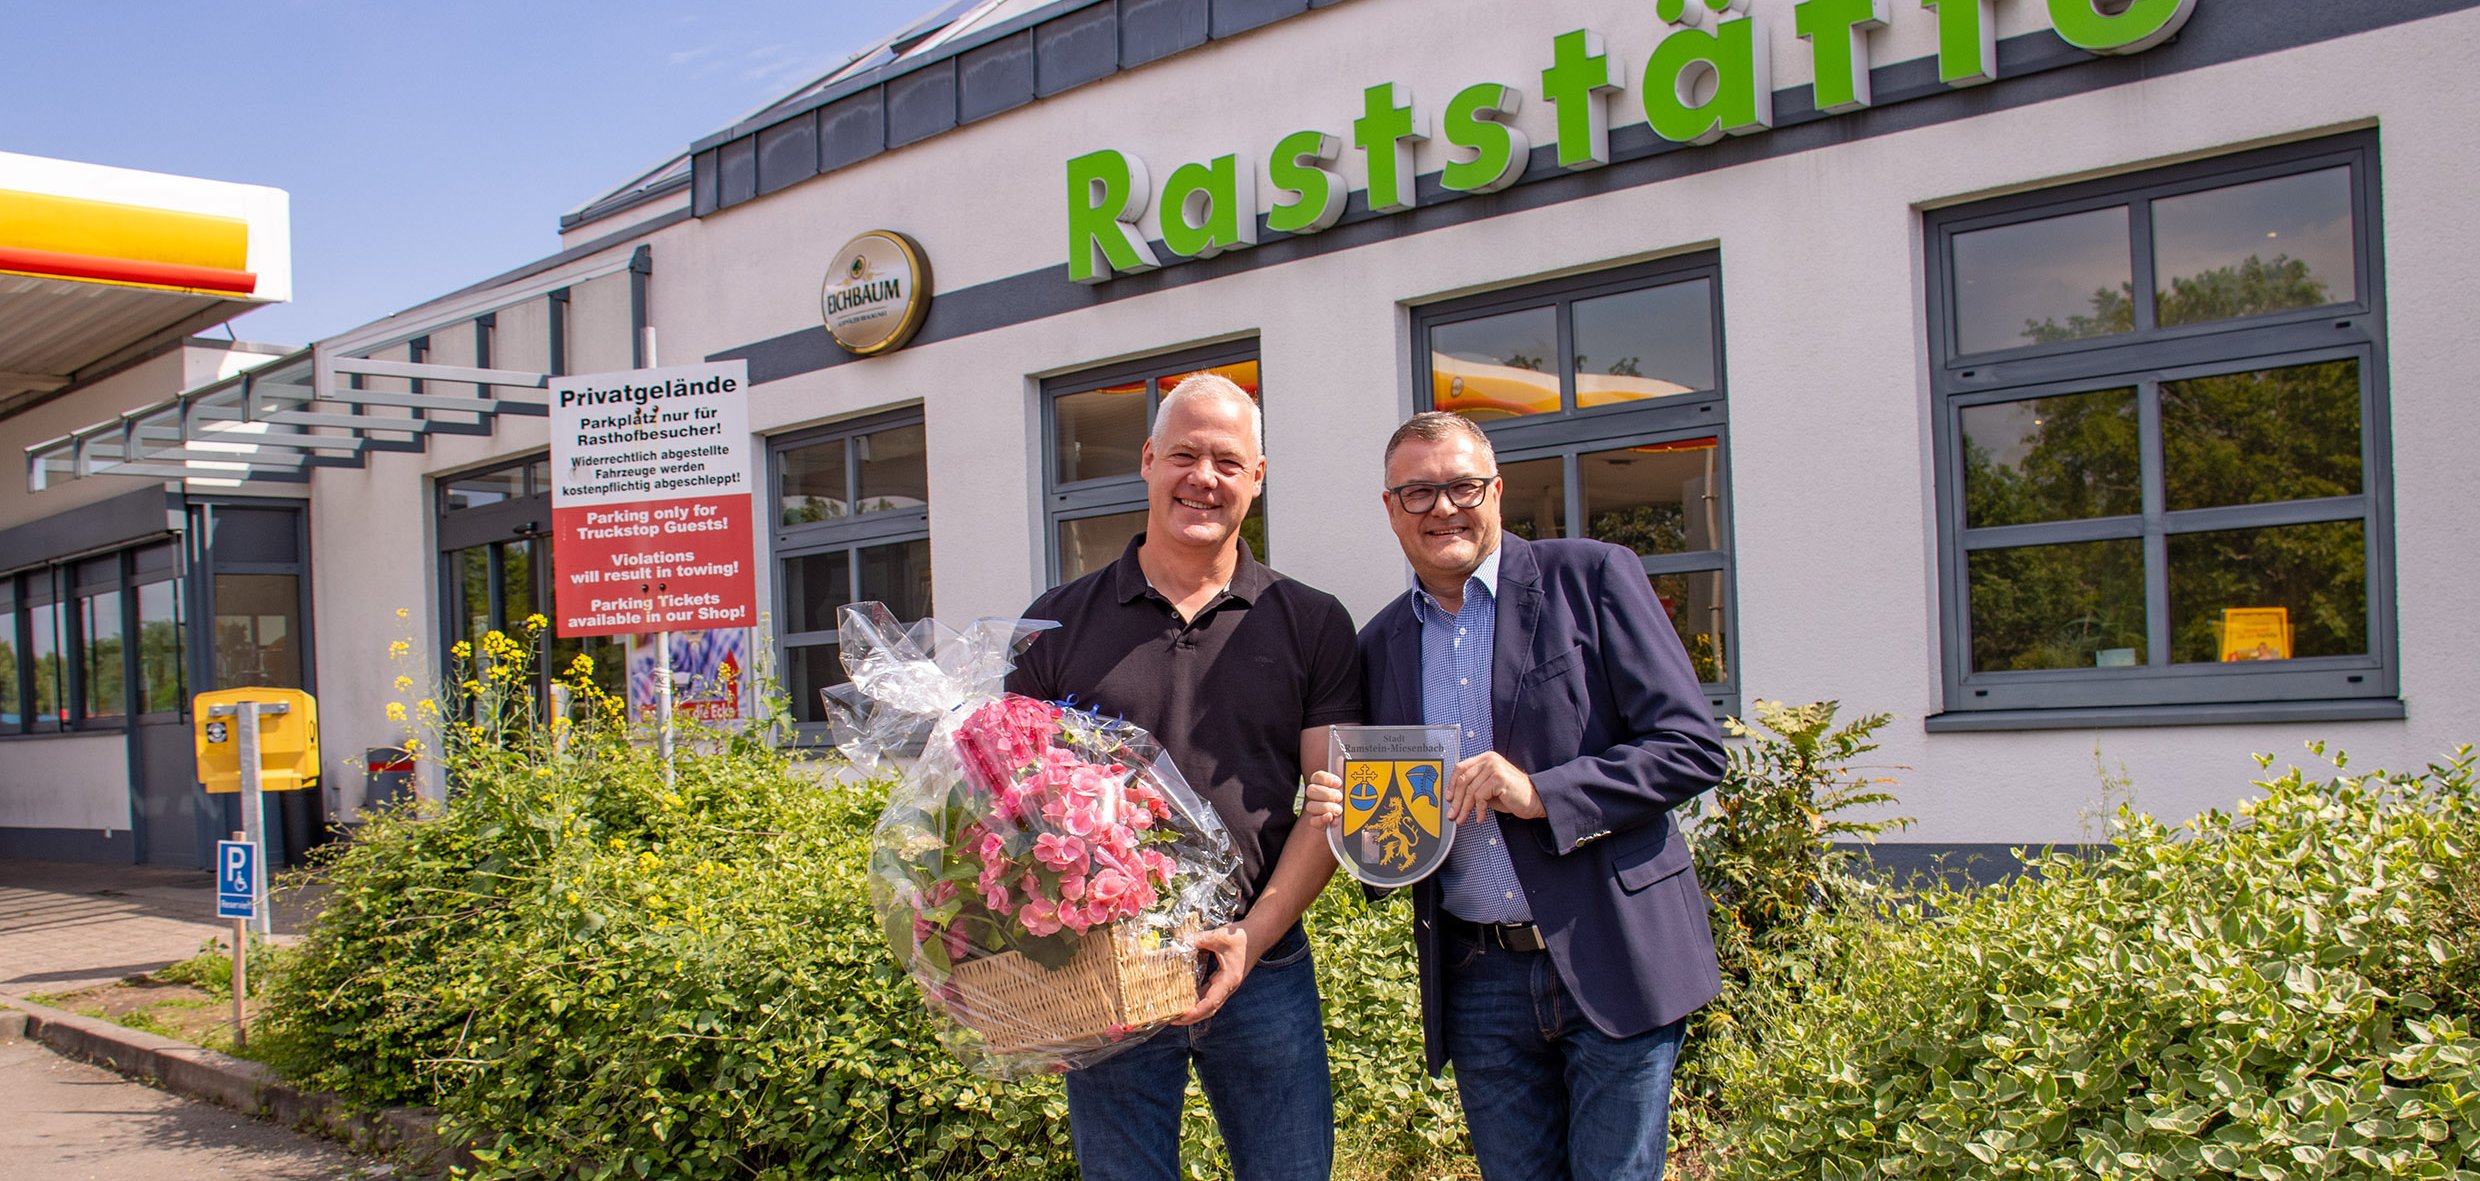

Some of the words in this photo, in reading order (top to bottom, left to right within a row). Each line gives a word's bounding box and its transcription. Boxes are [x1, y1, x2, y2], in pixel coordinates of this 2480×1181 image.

[828, 279, 900, 314] EICHBAUM
[560, 375, 737, 408] Privatgelände
[581, 411, 657, 431] Parkplatz
[662, 412, 689, 422] nur
[695, 407, 718, 420] für
[577, 423, 721, 447] Rasthofbesucher!
[571, 450, 657, 468] Widerrechtlich
[661, 445, 730, 461] abgestellte
[595, 465, 656, 480] Fahrzeuge
[660, 461, 705, 474] werden
[562, 479, 650, 497] kostenpflichtig
[654, 472, 741, 490] abgeschleppt!
[586, 509, 649, 525] Parking
[654, 505, 690, 520] only
[693, 504, 718, 517] for
[576, 522, 660, 540] Truckstop
[664, 517, 729, 534] Guests!
[611, 551, 695, 567] Violations
[570, 570, 599, 584] will
[604, 567, 652, 582] result
[656, 566, 673, 579] in
[676, 561, 739, 577] towing!
[591, 596, 653, 612] Parking
[658, 592, 721, 608] Tickets
[568, 612, 641, 628] available
[646, 610, 661, 624] in
[666, 609, 694, 622] our
[698, 605, 746, 621] Shop!
[1345, 743, 1445, 754] Ramstein-Miesenbach
[1383, 734, 1406, 744] Stadt
[227, 846, 246, 882] P
